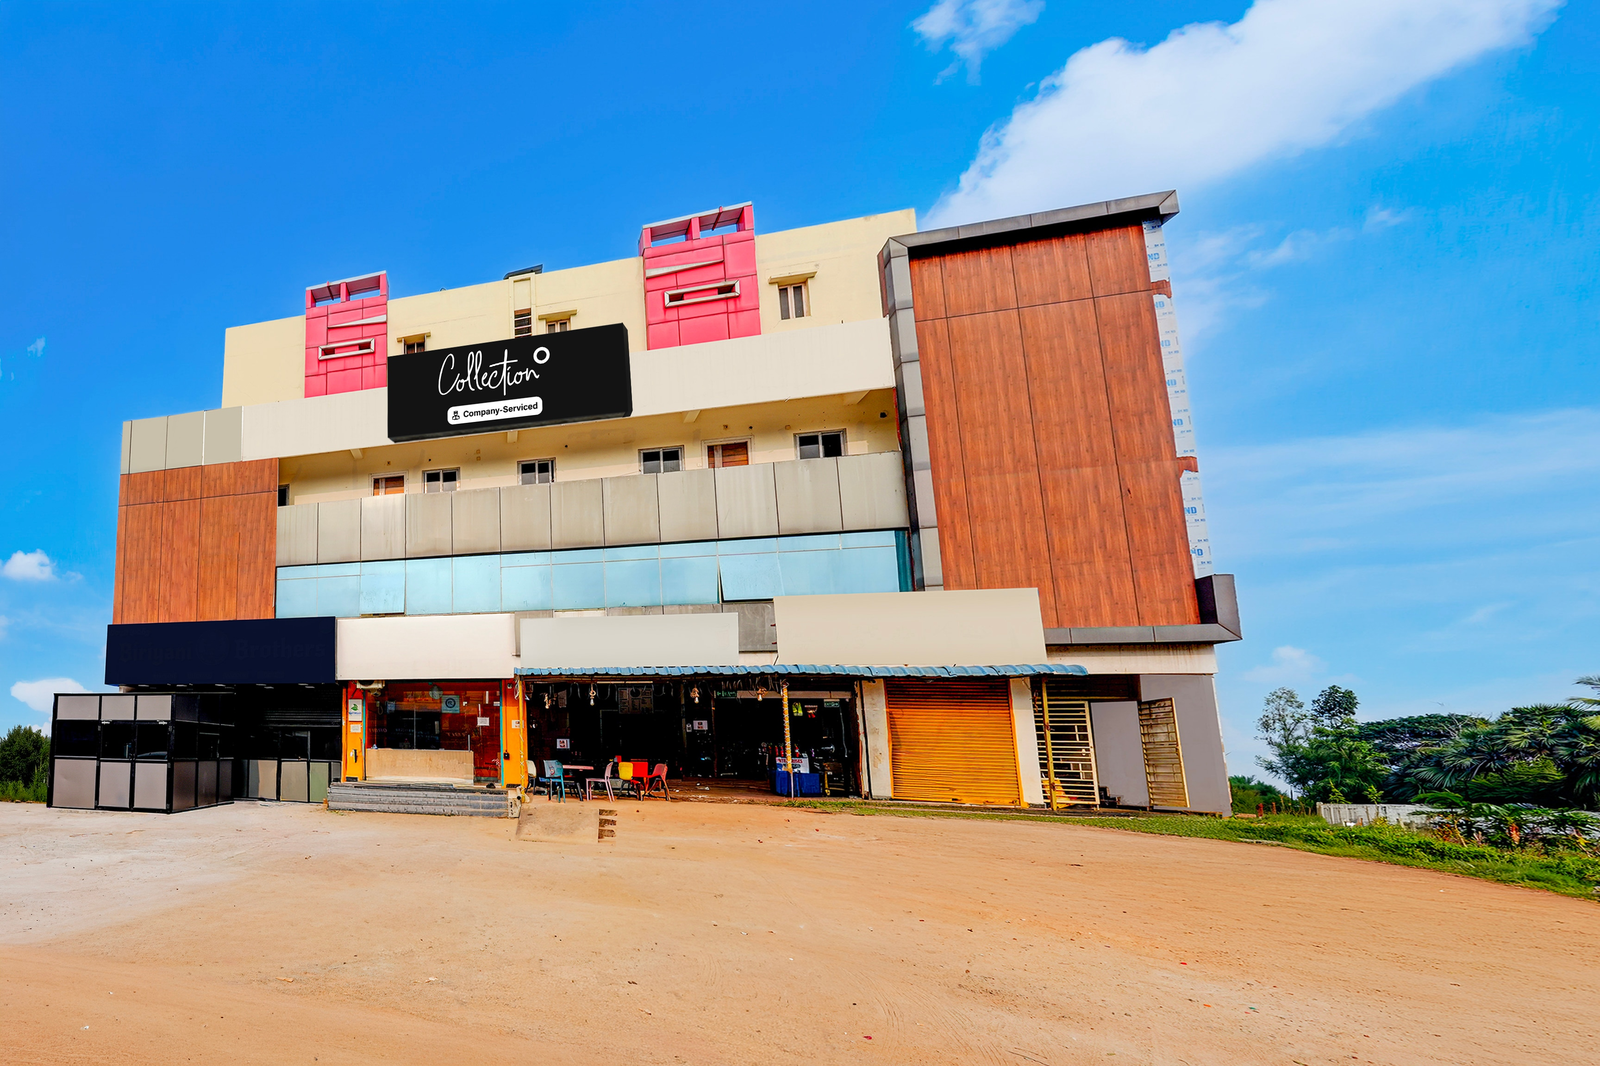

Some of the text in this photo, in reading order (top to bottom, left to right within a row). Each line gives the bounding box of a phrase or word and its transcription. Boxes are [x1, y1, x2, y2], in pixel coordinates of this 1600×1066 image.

[438, 349, 540, 396] Collection
[463, 401, 538, 418] Company-Serviced
[234, 637, 326, 661] Brothers
